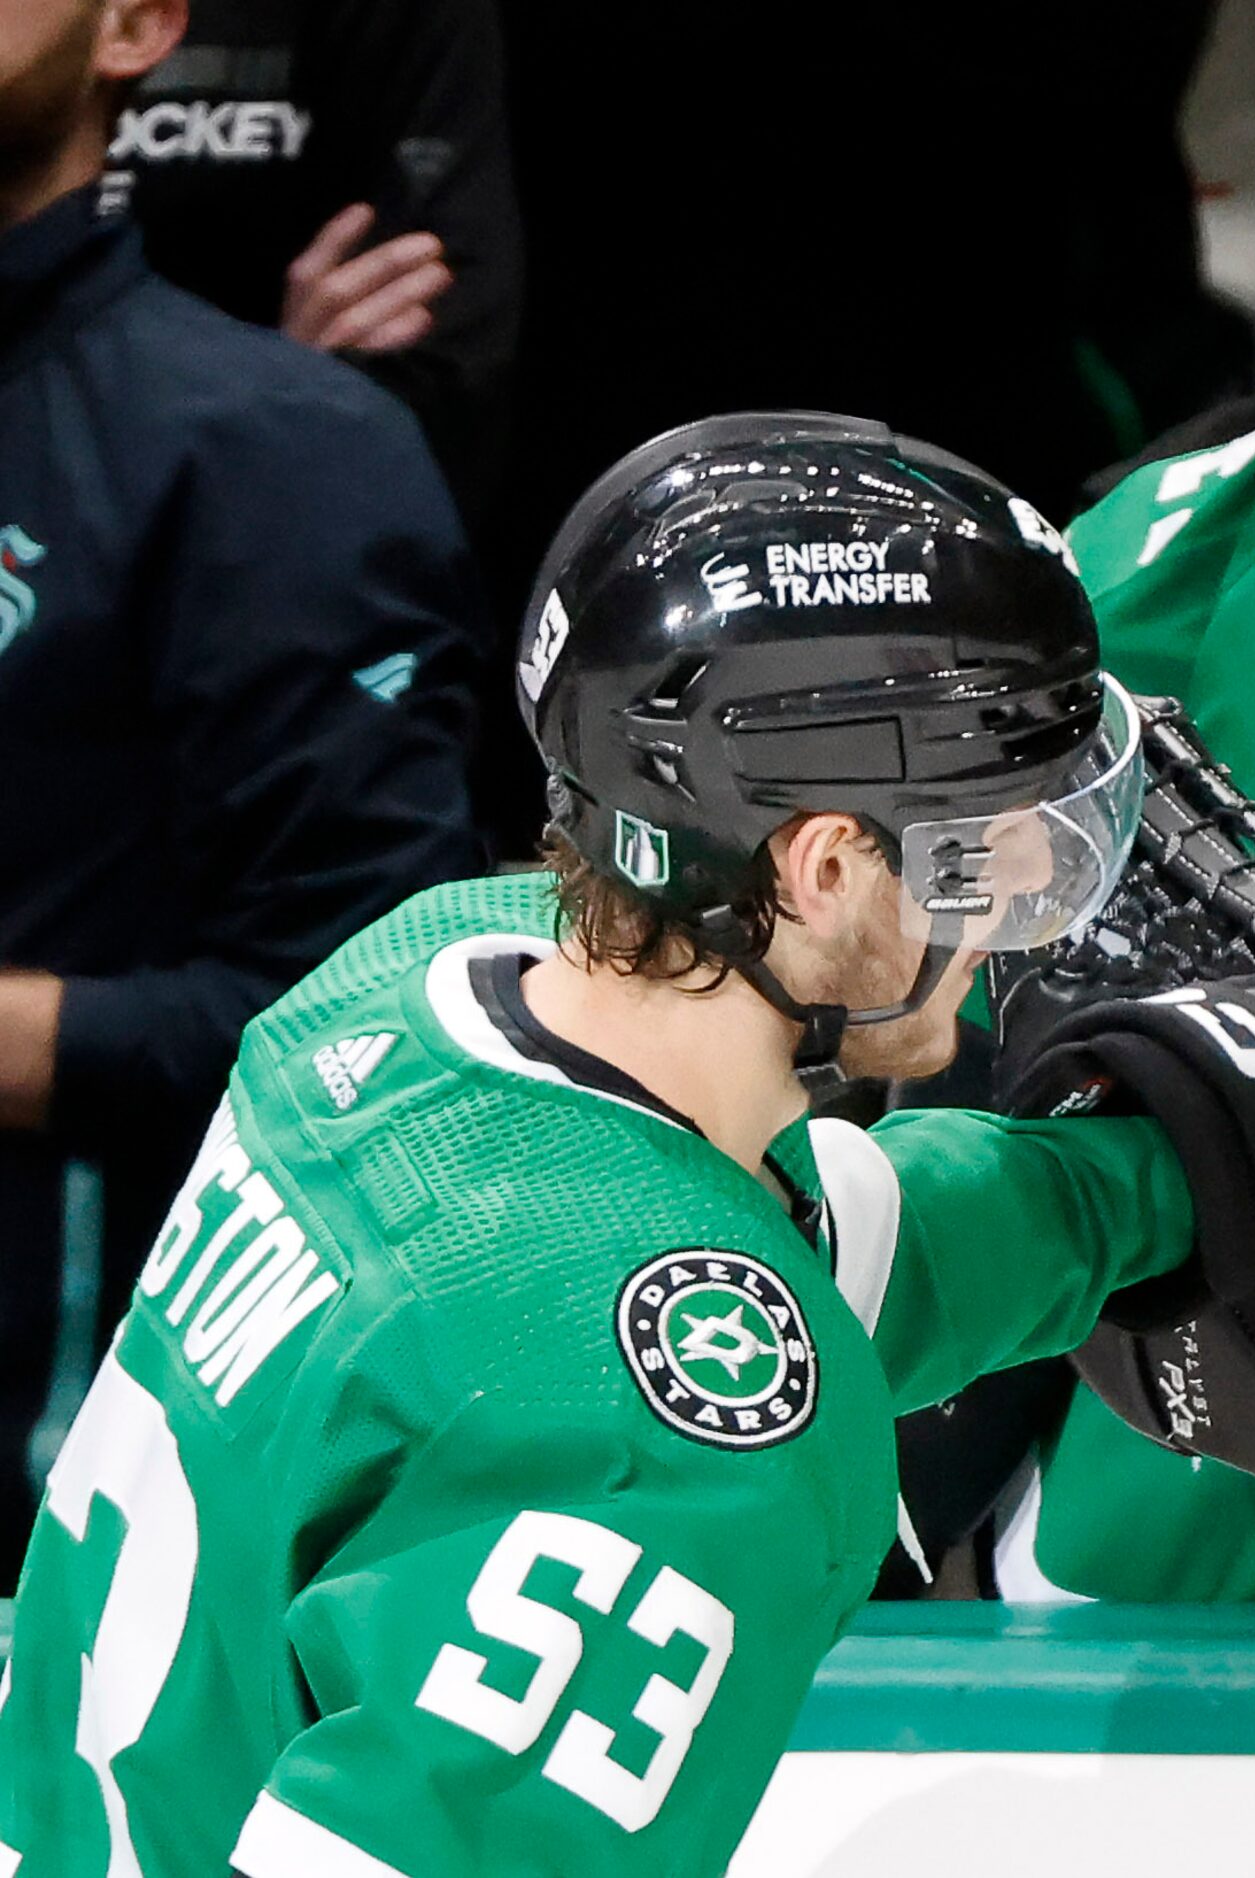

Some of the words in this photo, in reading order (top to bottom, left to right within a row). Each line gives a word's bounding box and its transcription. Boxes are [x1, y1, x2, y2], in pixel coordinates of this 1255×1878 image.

[766, 541, 890, 575] ENERGY
[768, 572, 932, 608] TRANSFER
[140, 1090, 340, 1408] STON
[638, 1261, 806, 1363] DALLAS
[639, 1346, 793, 1432] STARS
[413, 1509, 736, 1835] 53
